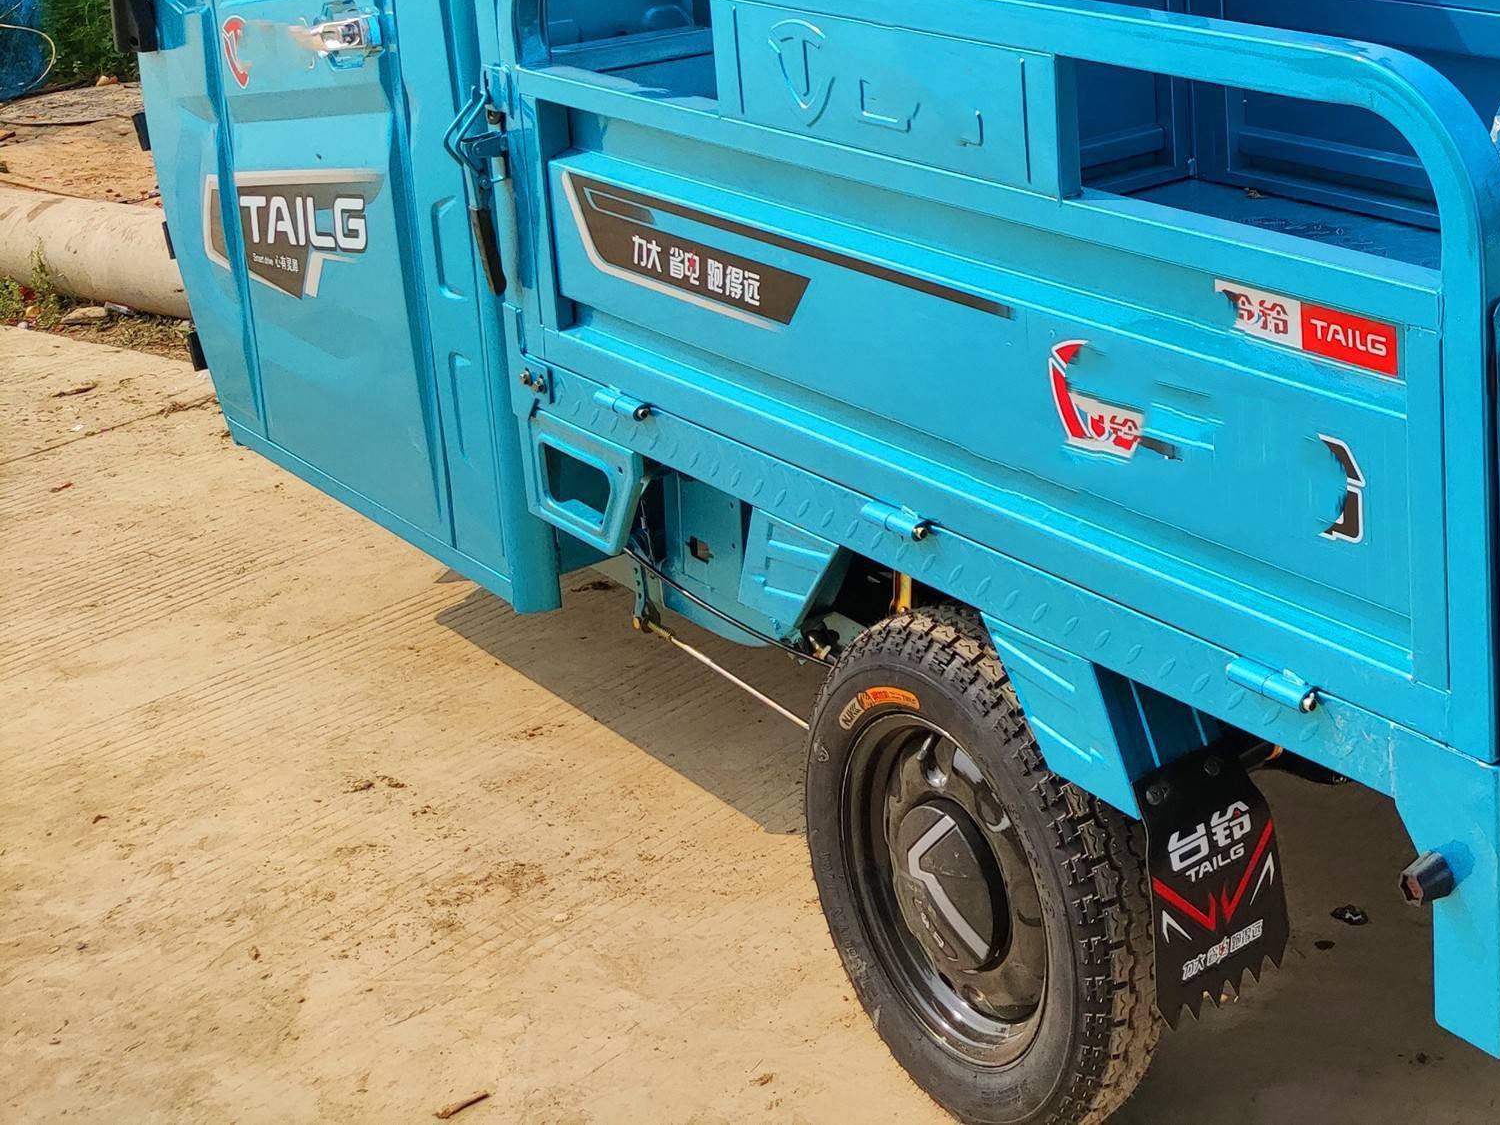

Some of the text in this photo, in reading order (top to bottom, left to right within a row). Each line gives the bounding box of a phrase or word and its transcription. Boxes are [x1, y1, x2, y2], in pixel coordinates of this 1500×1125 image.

[239, 194, 368, 252] TAILG
[631, 234, 663, 274] 力大
[707, 257, 761, 307] 跑得远
[1309, 318, 1388, 357] TAILG
[1167, 799, 1252, 874] 台铃
[1184, 842, 1245, 884] TAILG
